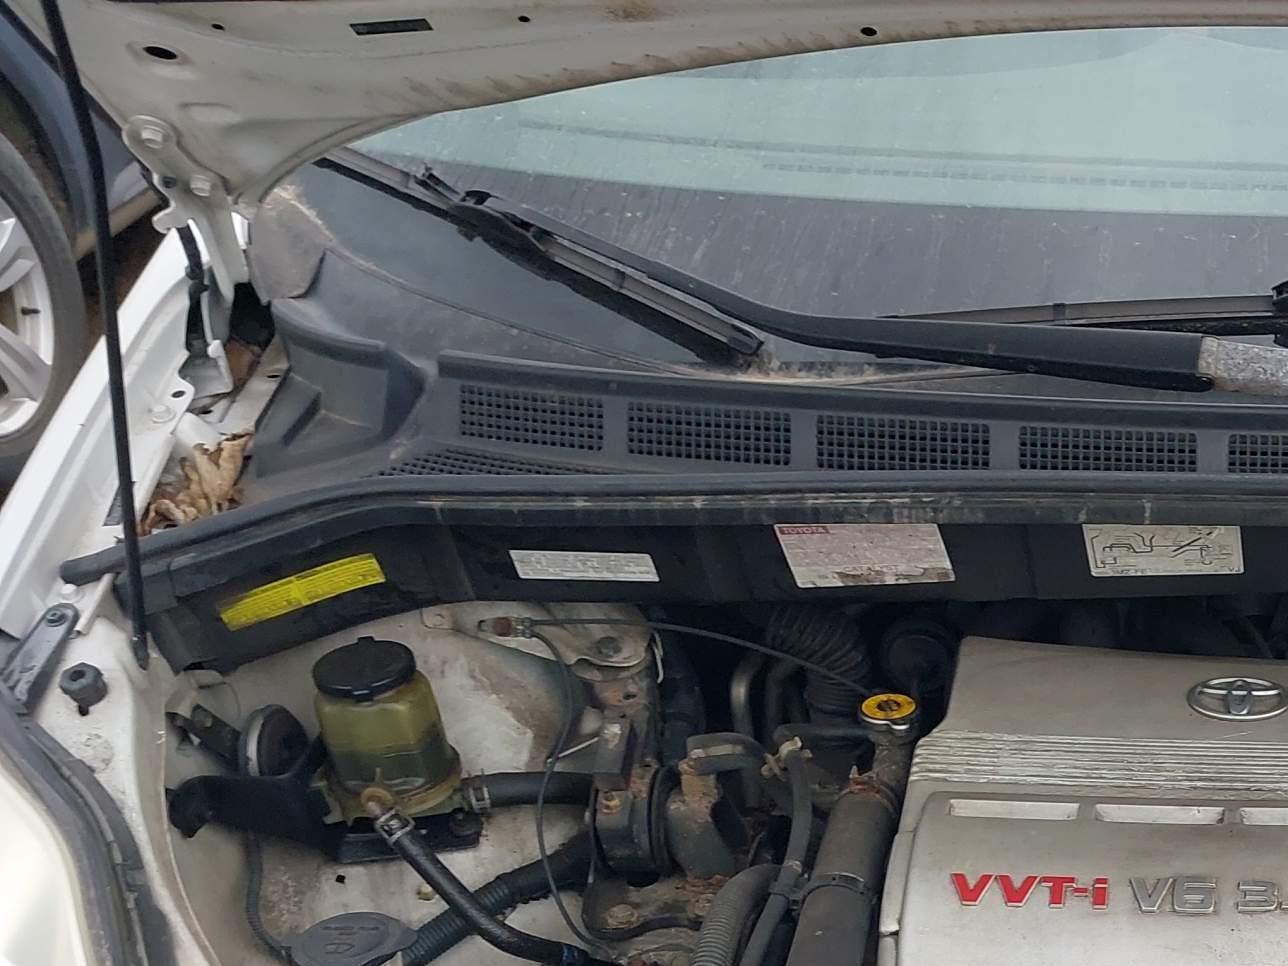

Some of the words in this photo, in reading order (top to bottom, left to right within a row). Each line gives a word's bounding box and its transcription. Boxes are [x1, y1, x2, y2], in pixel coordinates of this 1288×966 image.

[782, 526, 825, 534] TOYOTA
[951, 872, 1109, 910] VVT-i
[1128, 876, 1217, 914] V6
